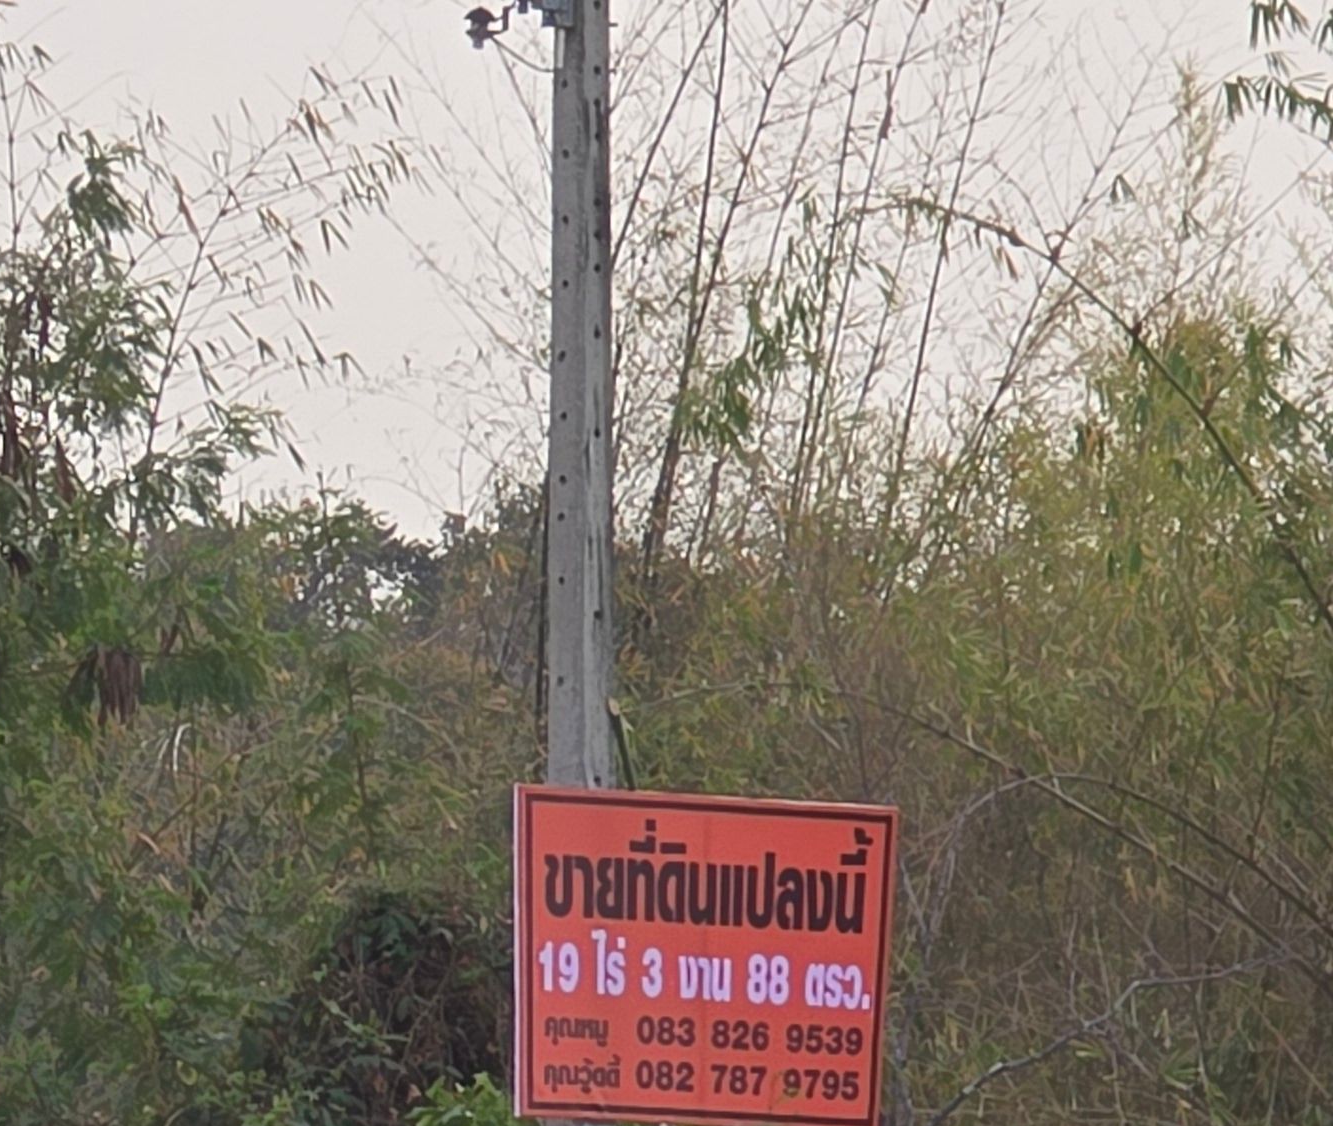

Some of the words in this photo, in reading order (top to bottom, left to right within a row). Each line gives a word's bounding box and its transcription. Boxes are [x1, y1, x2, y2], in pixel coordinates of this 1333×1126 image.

[544, 819, 873, 934] ขายที่ดินแปลงนี้
[539, 940, 580, 993] 19
[591, 928, 626, 996] ไร่
[641, 947, 663, 998] 3
[678, 954, 732, 1003] งาน
[746, 953, 790, 1006] 88
[636, 1015, 695, 1047] 083
[711, 1019, 770, 1051] 826
[786, 1023, 864, 1056] 9539
[636, 1059, 695, 1093] 082
[711, 1064, 767, 1097] 787
[782, 1068, 860, 1102] 9795
